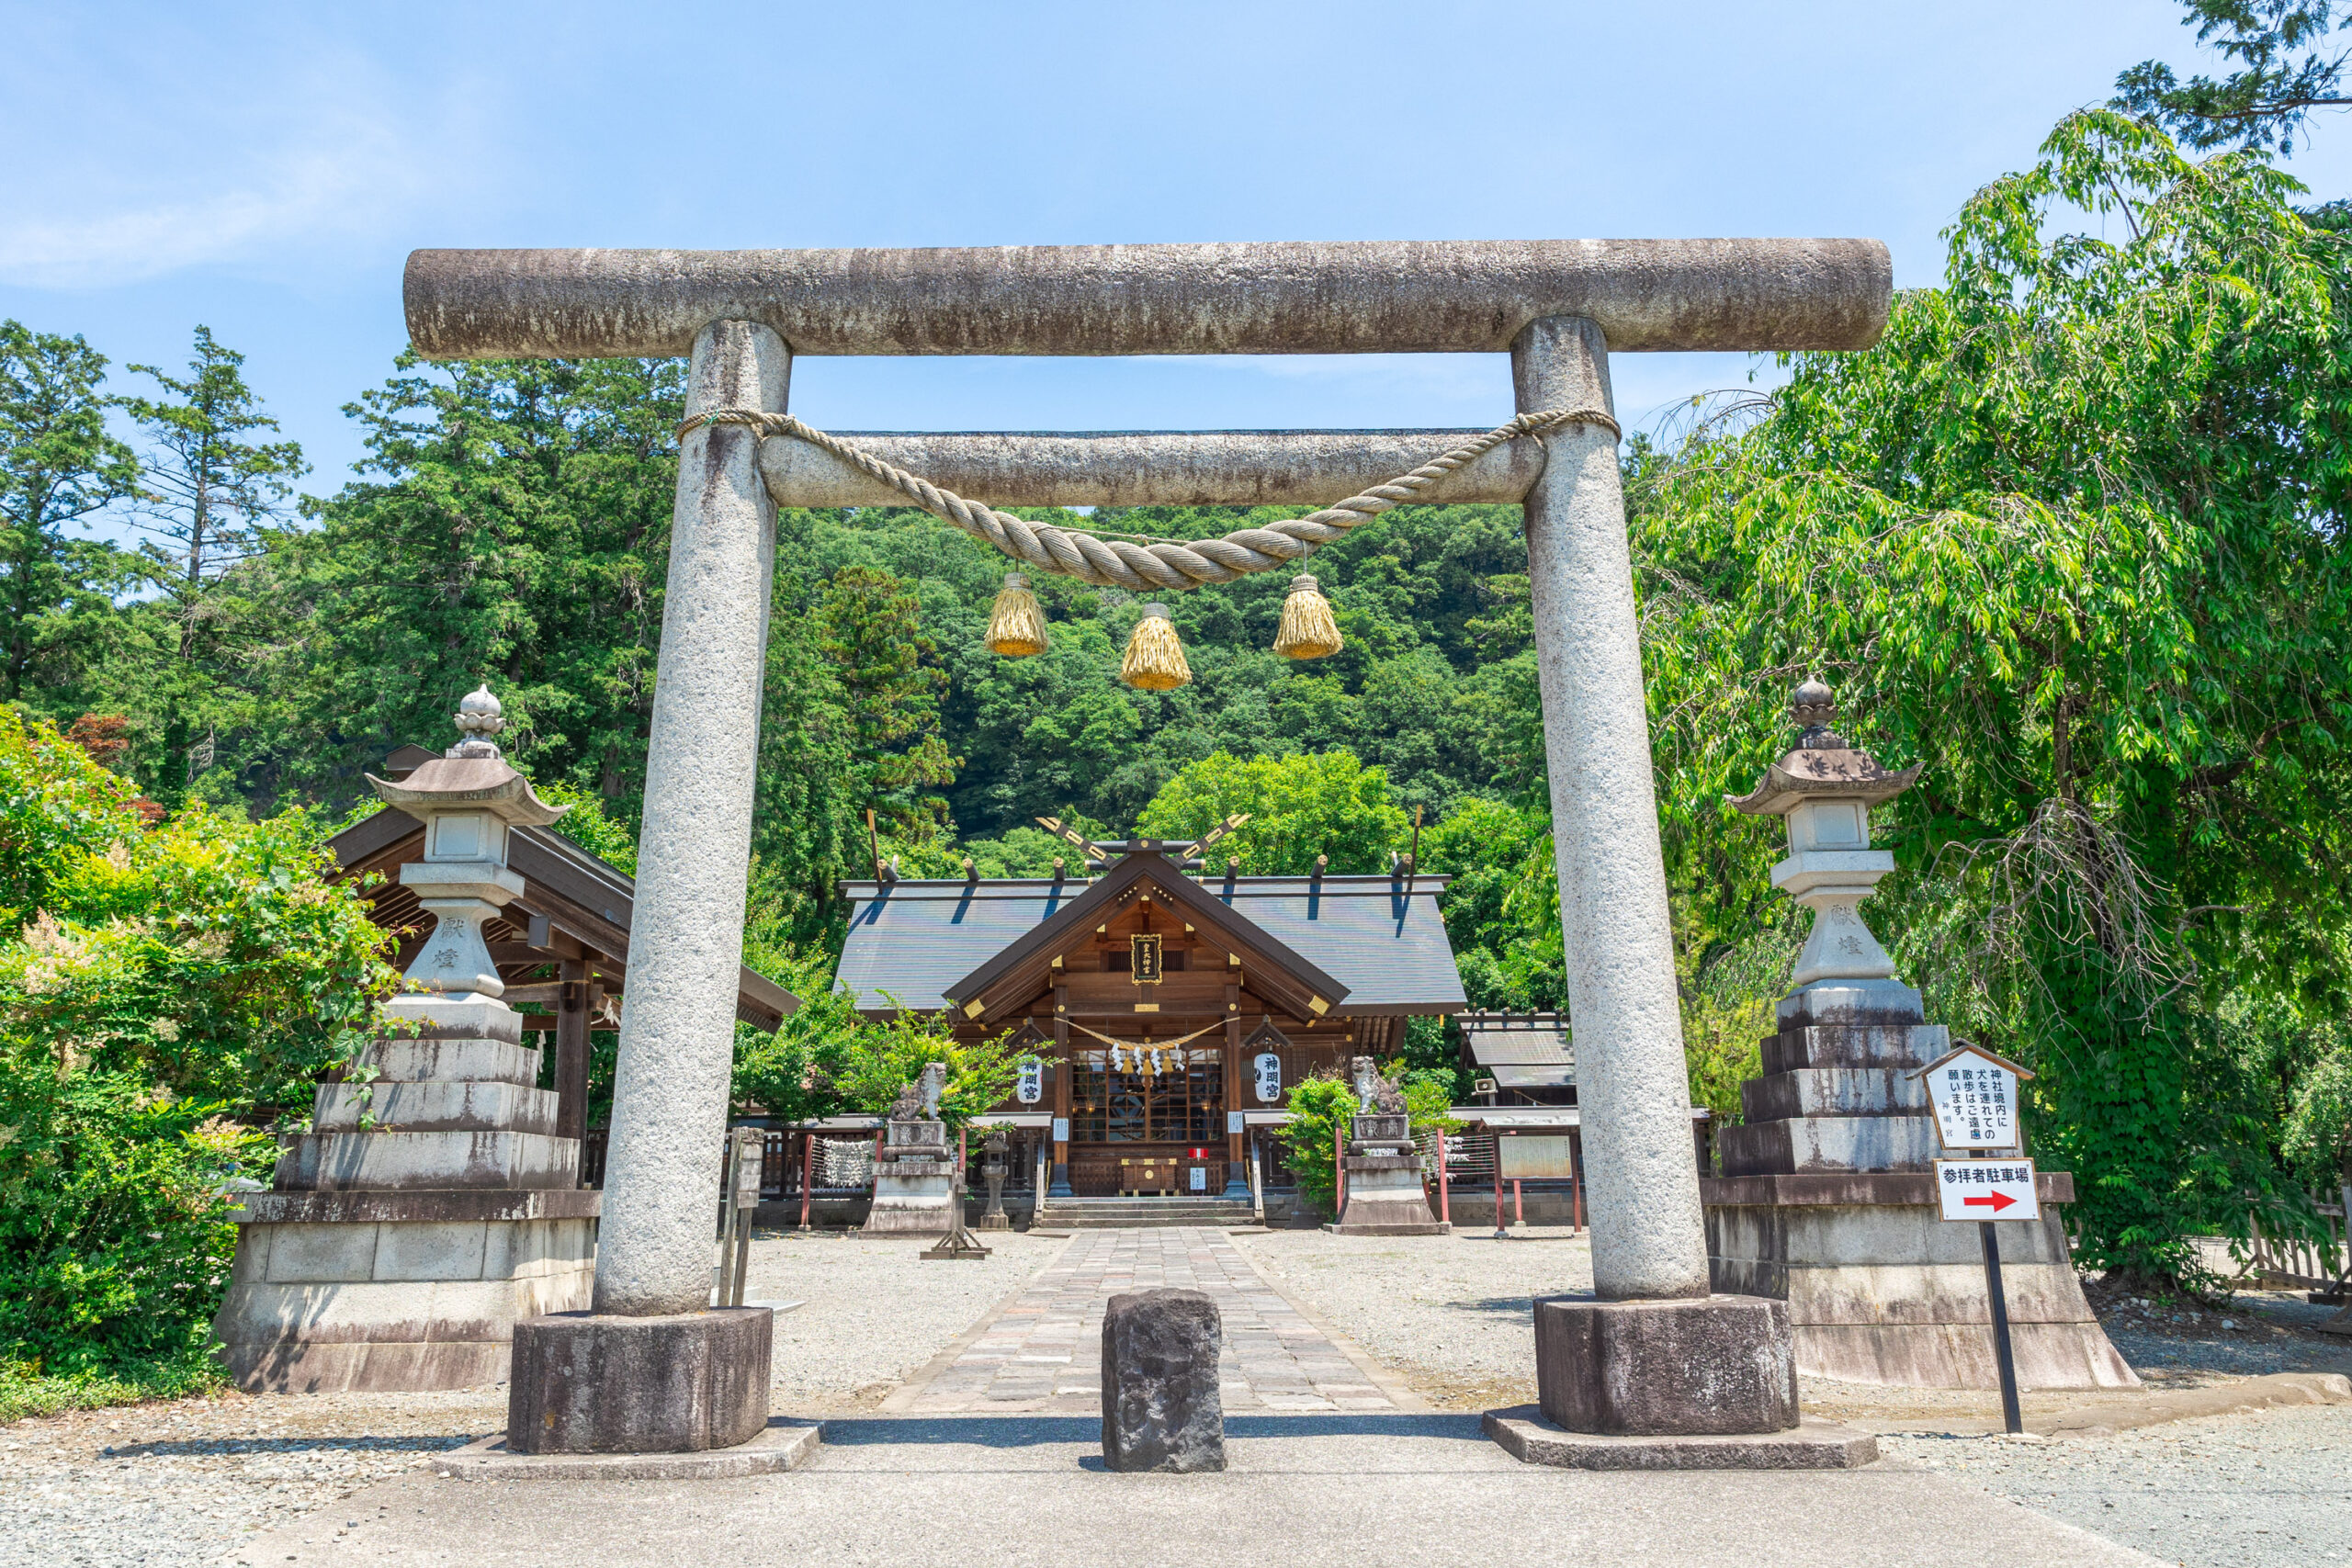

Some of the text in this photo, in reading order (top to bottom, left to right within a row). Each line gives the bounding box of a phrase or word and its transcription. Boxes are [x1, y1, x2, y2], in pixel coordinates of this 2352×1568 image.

[1024, 1058, 1038, 1100] 神明宮
[1264, 1056, 1279, 1098] 神明宮
[1947, 1068, 1965, 1122] 願います。
[1990, 1068, 2007, 1127] 神社境内に
[1941, 1101, 1953, 1137] 神明宮
[1962, 1068, 1982, 1140] 散歩はご遠慮
[1976, 1068, 1996, 1140] 犬を連れての
[1943, 1168, 2030, 1184] 参拝者駐車場
